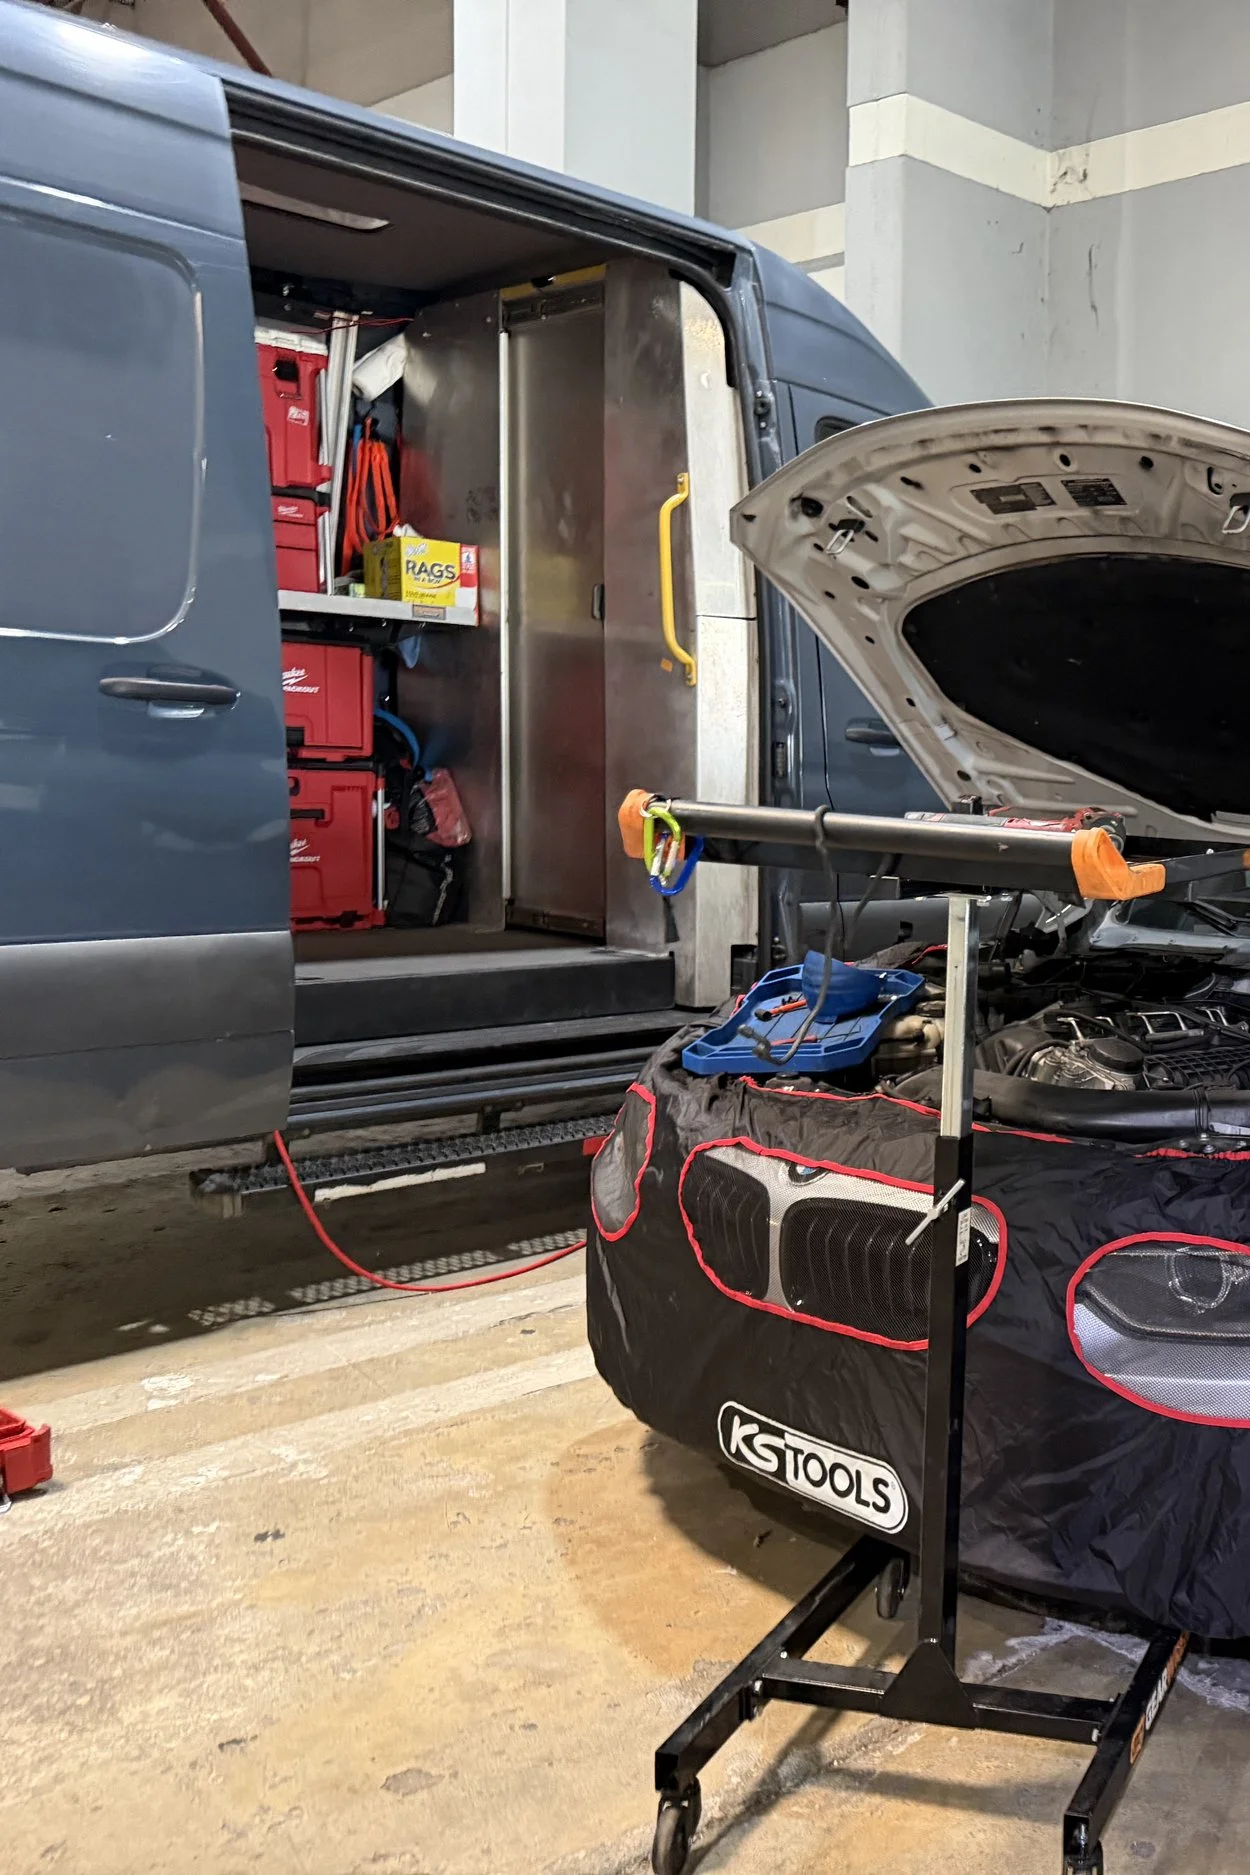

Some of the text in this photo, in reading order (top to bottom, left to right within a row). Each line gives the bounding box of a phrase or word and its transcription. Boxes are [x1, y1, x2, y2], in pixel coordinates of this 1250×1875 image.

[405, 559, 456, 580] RAGS
[730, 1415, 891, 1514] KS TOOLS
